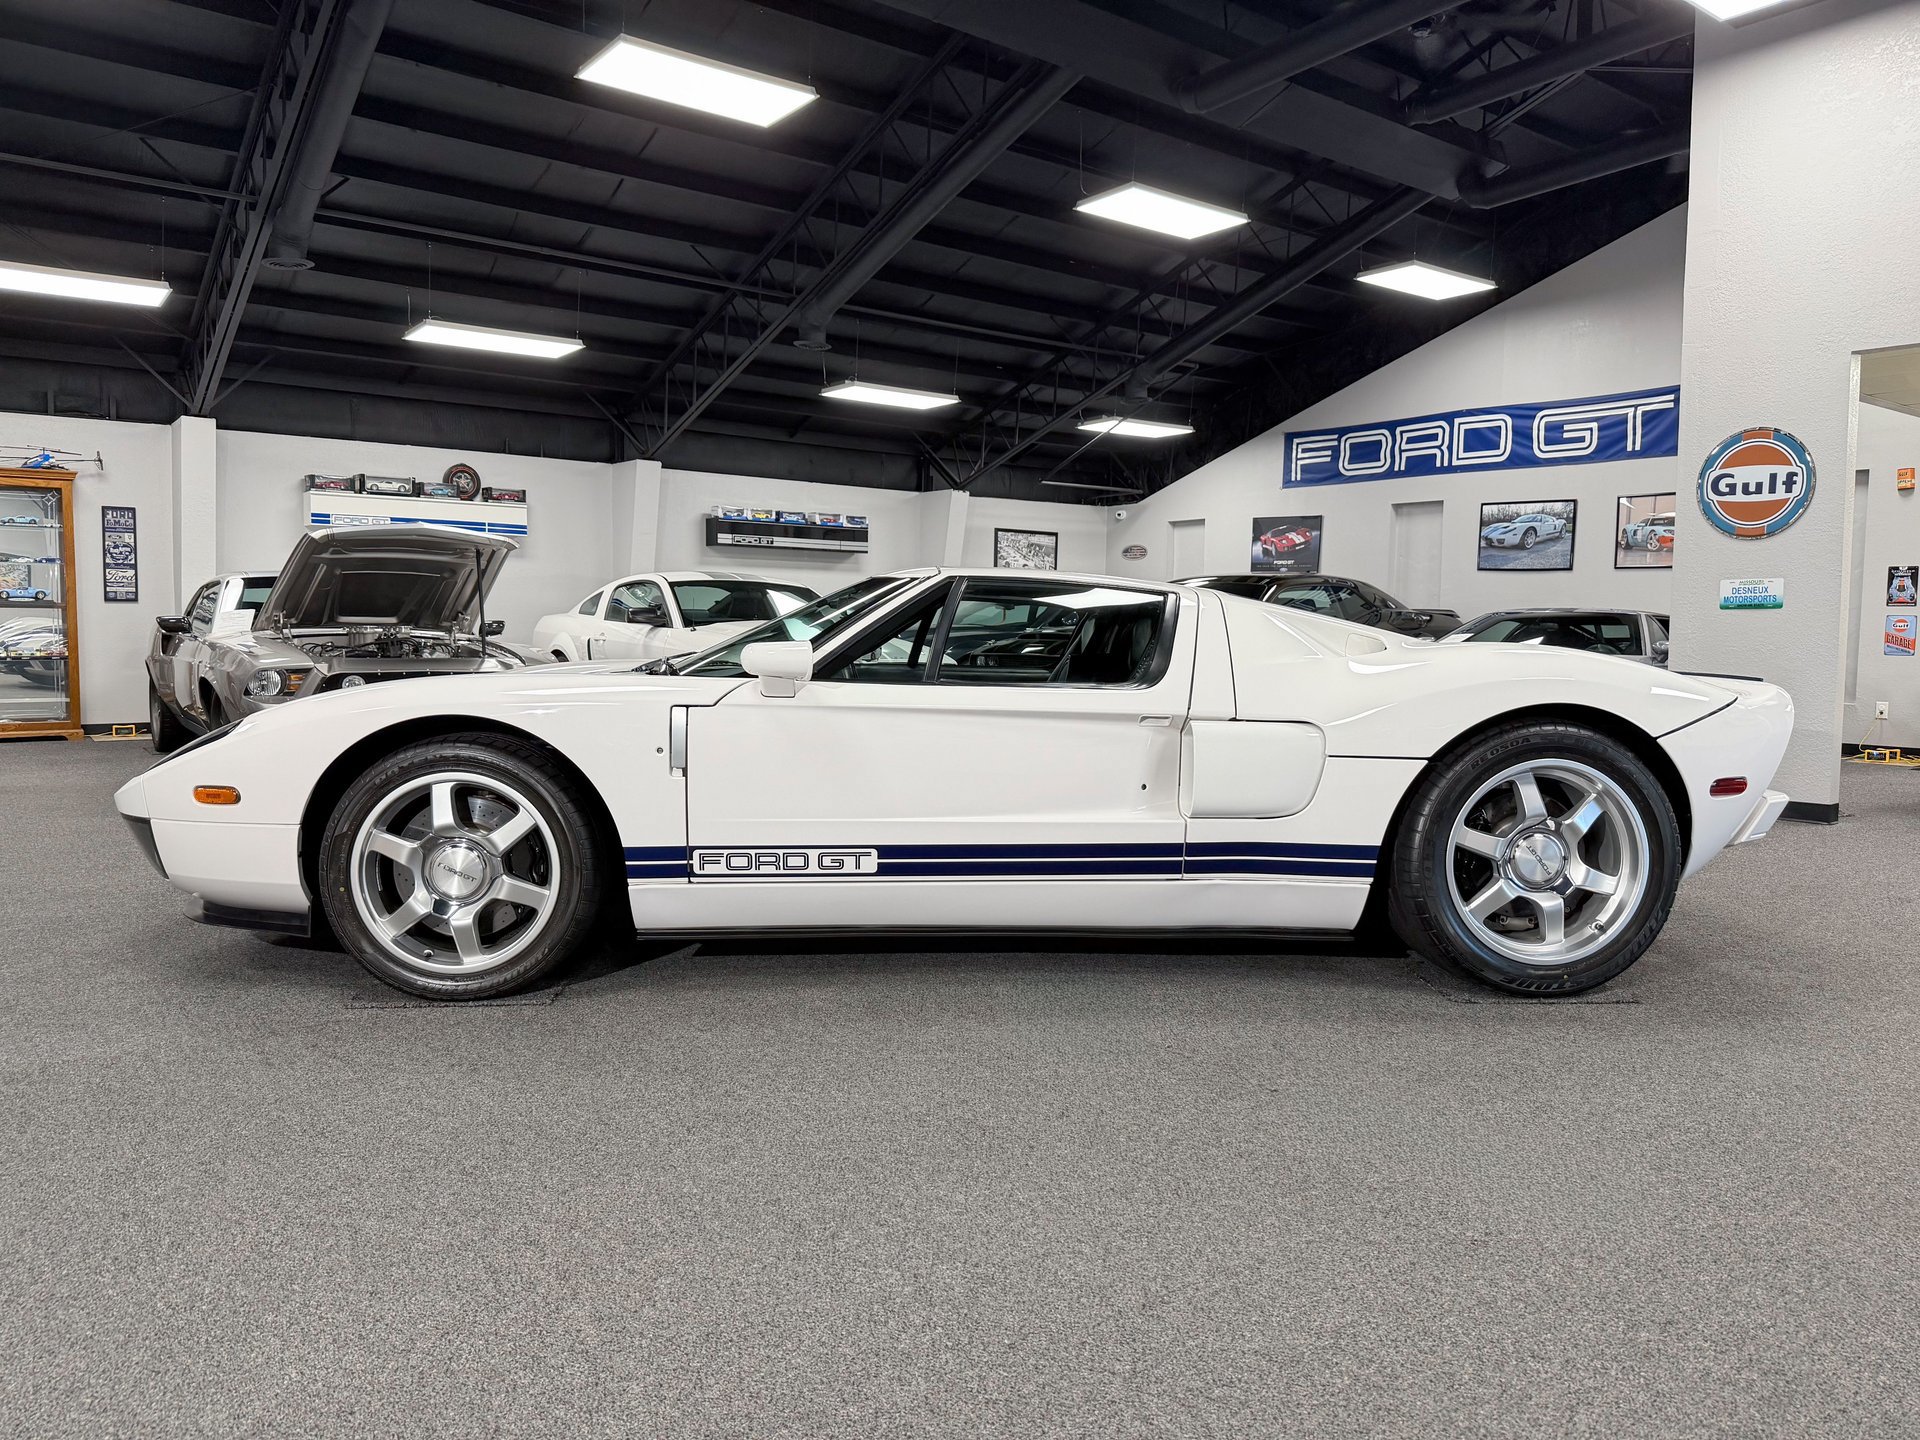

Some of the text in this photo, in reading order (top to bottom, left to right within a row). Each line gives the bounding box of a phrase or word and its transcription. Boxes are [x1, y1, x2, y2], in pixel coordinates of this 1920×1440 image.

[1290, 394, 1675, 482] FORD GT
[1710, 472, 1799, 497] Gulf
[104, 509, 134, 519] FORD
[106, 519, 133, 527] FoMoCo
[333, 516, 389, 526] FORD GT
[106, 569, 136, 581] Ford
[1731, 586, 1769, 595] DESNEUX
[1723, 595, 1777, 604] MOTORSPORTS
[1886, 633, 1912, 650] GARAGE
[698, 851, 872, 871] FORD GT
